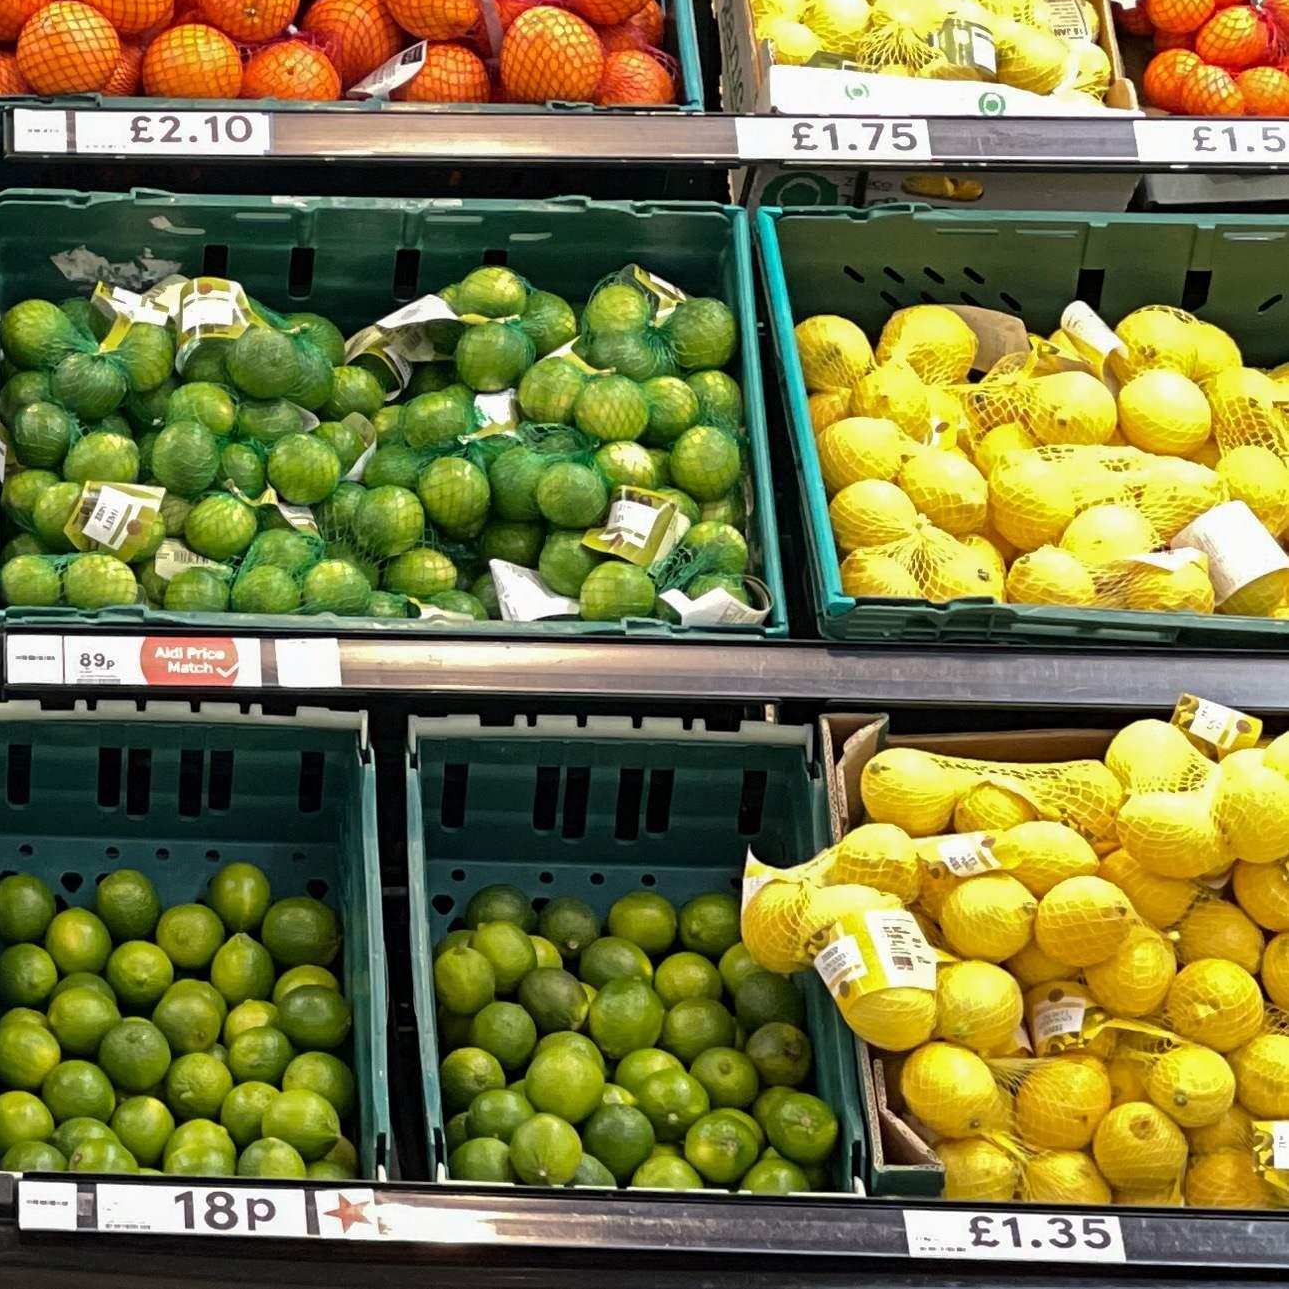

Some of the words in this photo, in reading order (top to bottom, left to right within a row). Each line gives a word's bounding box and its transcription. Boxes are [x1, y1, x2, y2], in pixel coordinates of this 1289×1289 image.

[129, 115, 254, 143] £2.10
[791, 122, 918, 152] £1.75
[79, 652, 115, 669] 89p
[154, 646, 182, 659] Aldi
[187, 646, 225, 660] Price
[167, 661, 213, 674] Match
[174, 1190, 276, 1231] 18p
[969, 1215, 1112, 1249] £1.35
